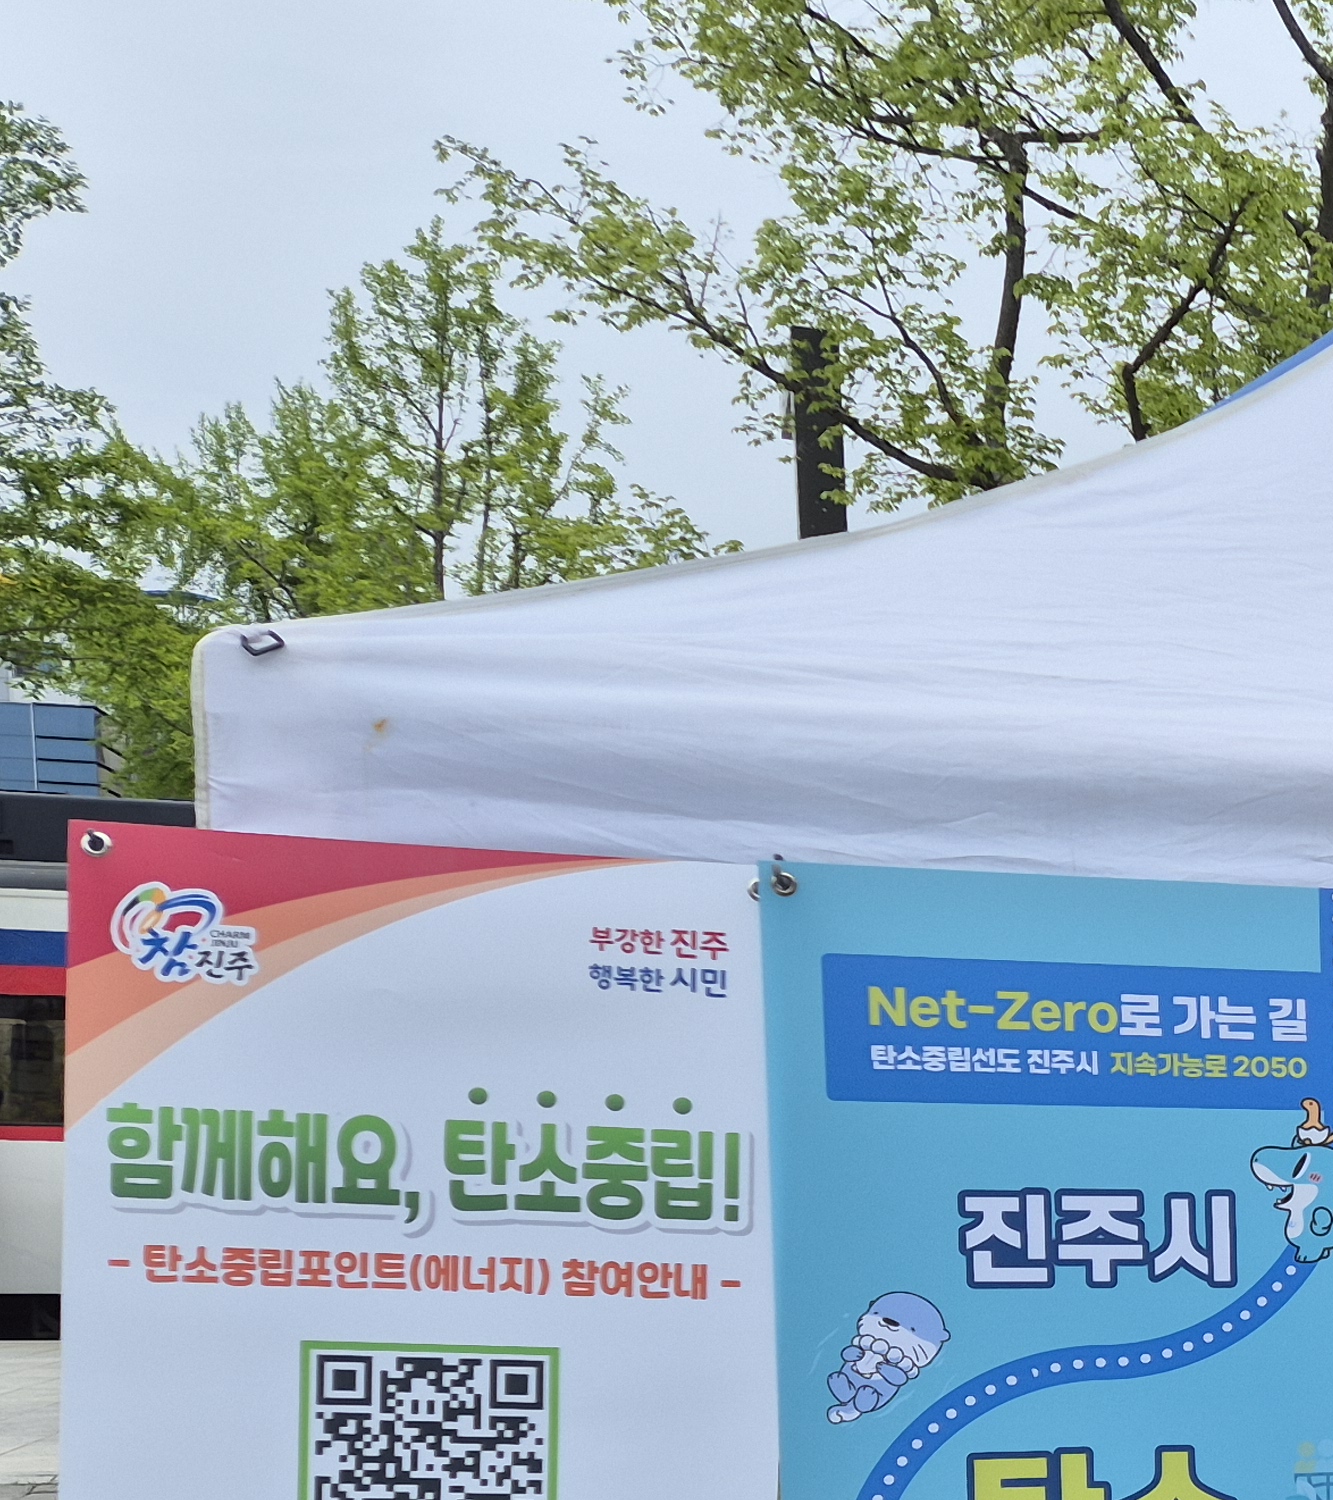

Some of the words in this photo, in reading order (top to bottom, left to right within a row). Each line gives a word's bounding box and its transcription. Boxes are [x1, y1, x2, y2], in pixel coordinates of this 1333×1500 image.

[589, 926, 665, 955] 부강한
[669, 927, 731, 961] 진주
[588, 963, 665, 994] 행복한
[669, 966, 730, 999] 시민
[866, 985, 1163, 1039] Net-Zero로
[1171, 995, 1260, 1041] 가는
[1267, 997, 1309, 1044] 길
[870, 1044, 1022, 1075] 탄소중립선도
[1026, 1049, 1100, 1077] 진주시
[1108, 1051, 1229, 1080] 지속가능로
[1232, 1056, 1308, 1080] 2050
[105, 1102, 420, 1225] 함께해요,
[442, 1115, 744, 1223] 탄소중립!
[961, 1190, 1236, 1287] 진주시
[142, 1243, 550, 1296] 탄소중립포인트(에너지)
[560, 1258, 709, 1301] 참여안내
